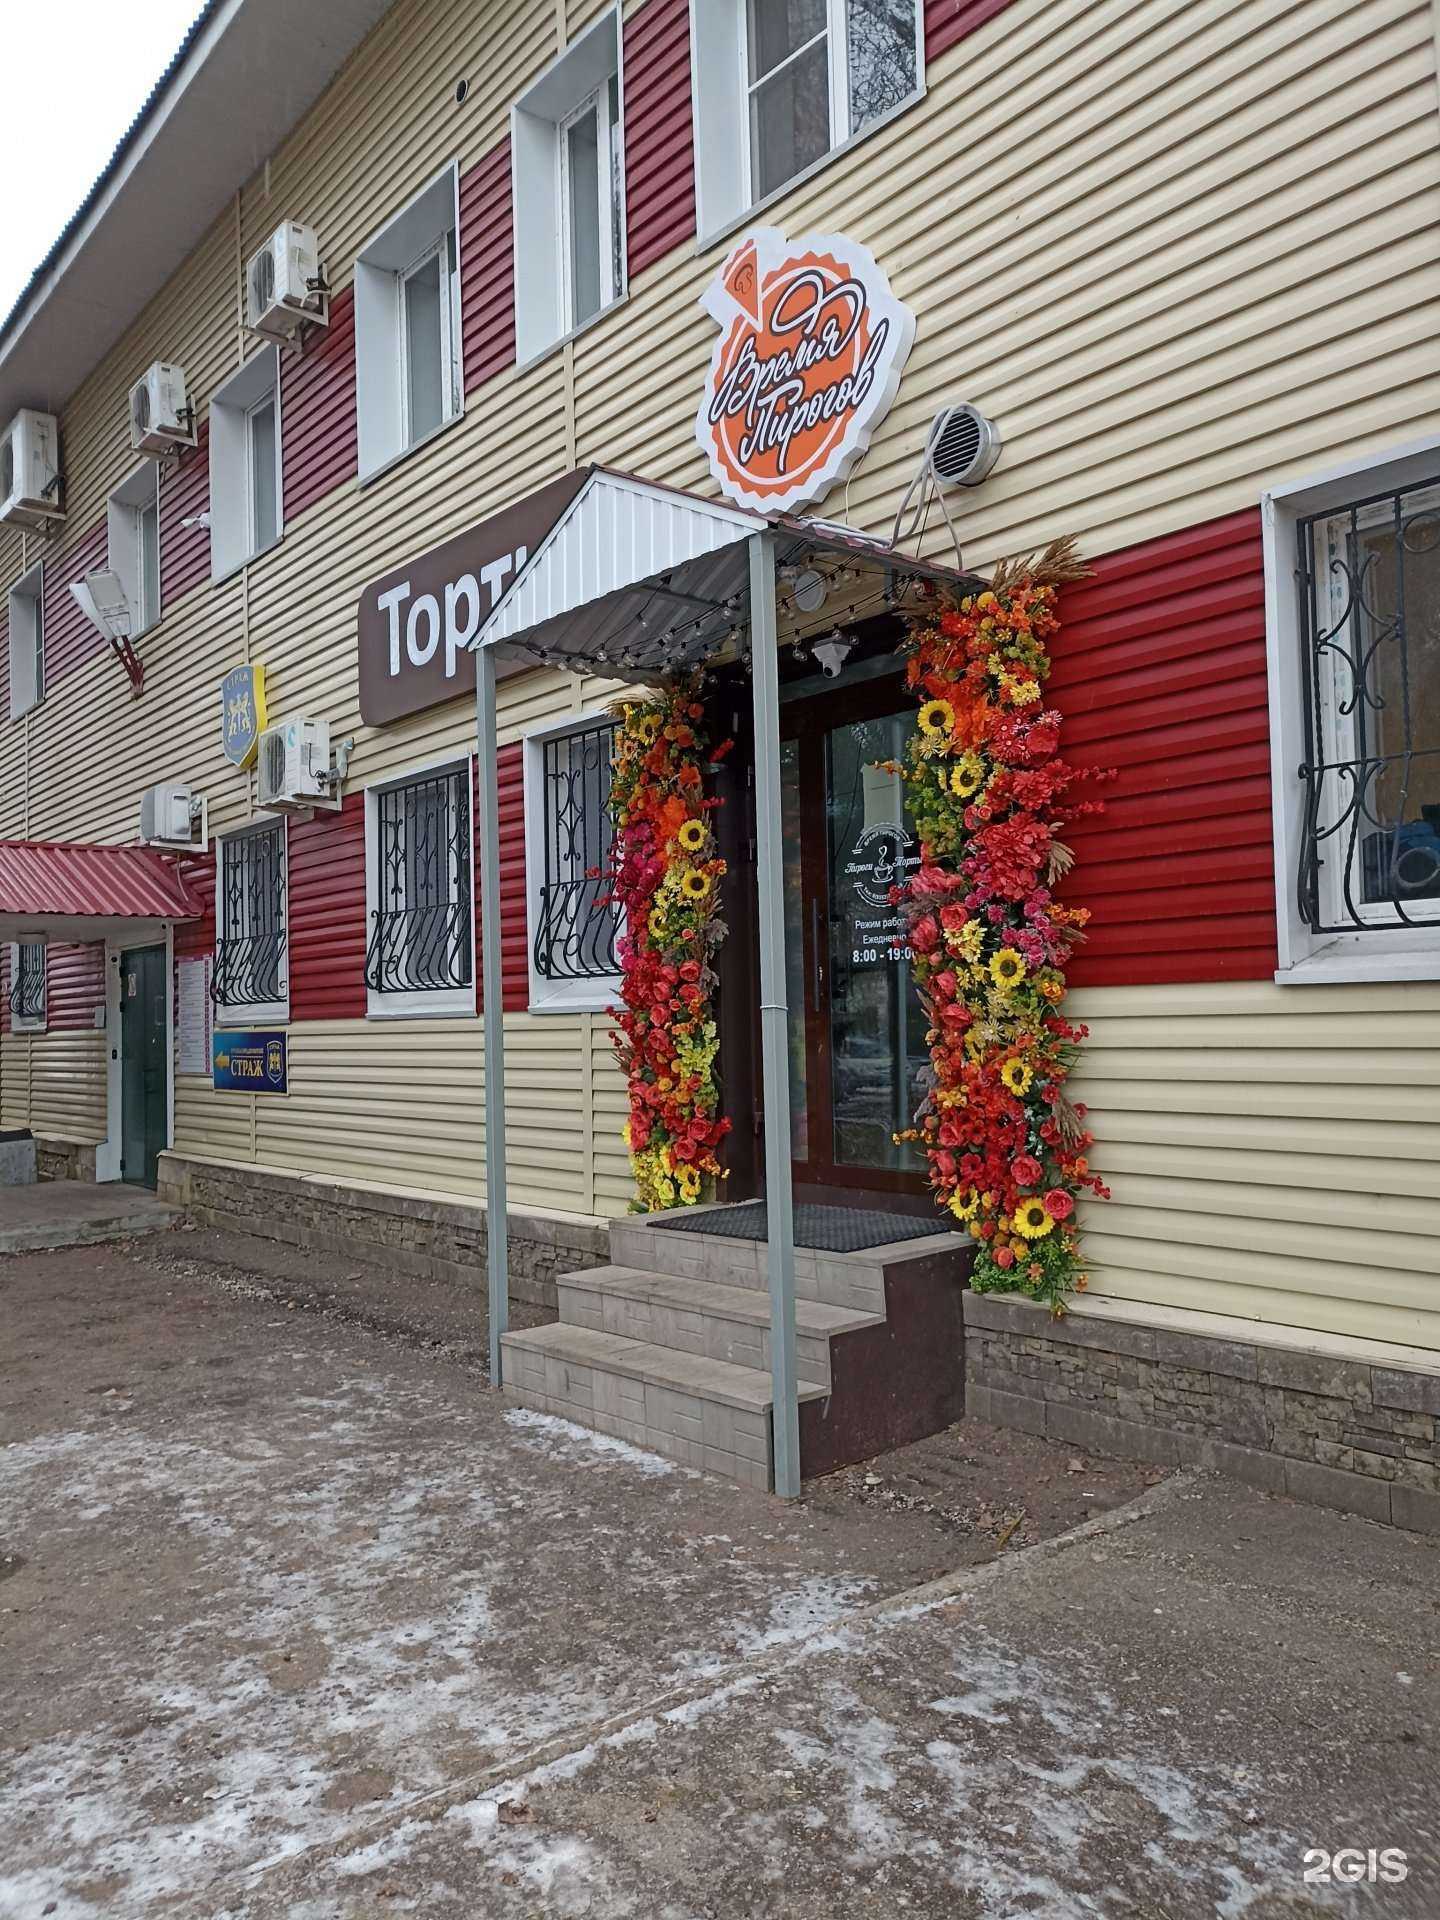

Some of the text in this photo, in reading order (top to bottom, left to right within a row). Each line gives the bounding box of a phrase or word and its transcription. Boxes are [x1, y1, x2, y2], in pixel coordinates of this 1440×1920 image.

[708, 270, 866, 426] Время
[739, 317, 889, 474] Пирогов
[855, 920, 881, 929] Режим
[852, 948, 877, 963] 8:00
[230, 1059, 264, 1077] СТРАЖ
